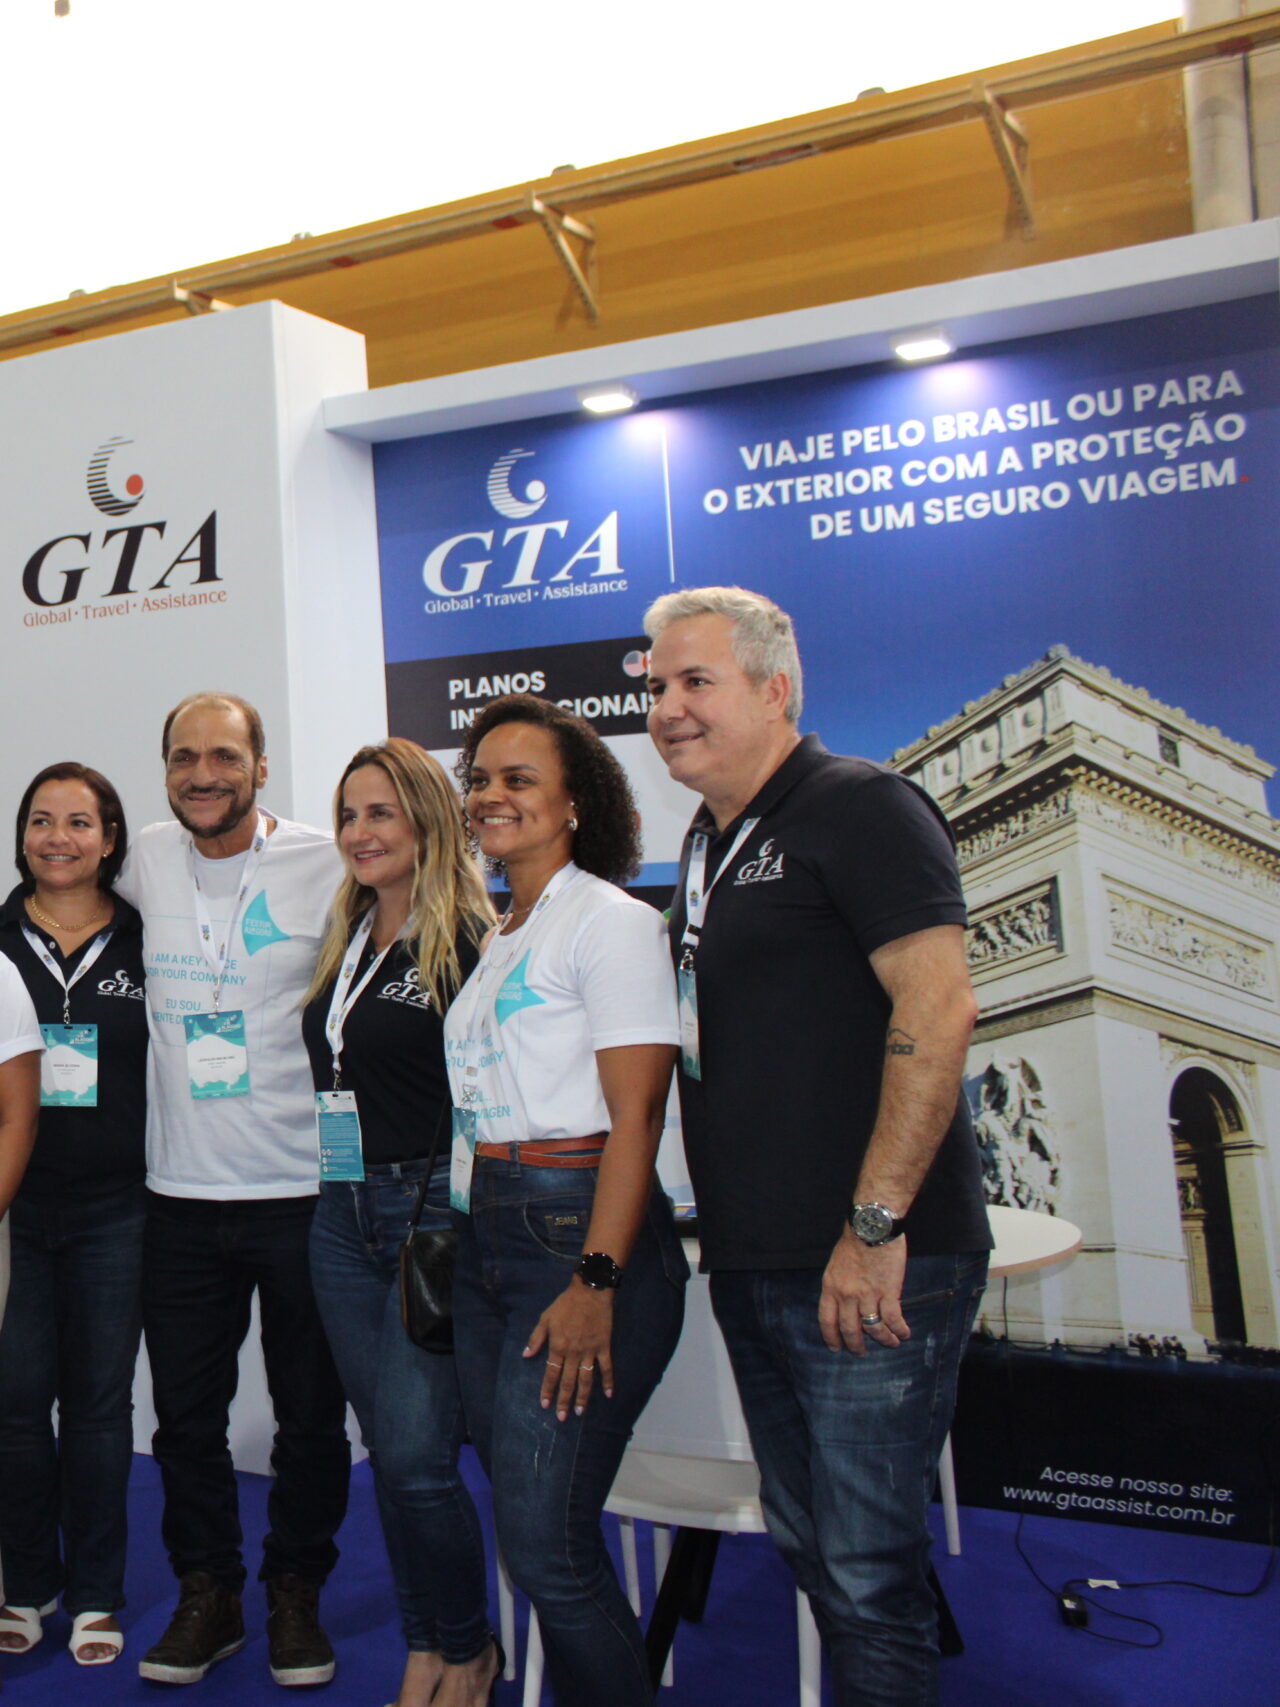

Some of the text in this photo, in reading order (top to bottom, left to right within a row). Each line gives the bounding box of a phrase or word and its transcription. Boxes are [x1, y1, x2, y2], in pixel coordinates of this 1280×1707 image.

[739, 368, 1245, 472] VIAJE PELO BRASIL OU PARA
[702, 411, 1247, 515] O EXTERIOR COM A PROTEÇÃO
[809, 512, 854, 541] DE
[859, 500, 917, 535] UM
[922, 480, 1072, 526] SEGURO
[21, 509, 224, 608] GTA
[421, 510, 625, 598] GTA
[23, 589, 229, 628] Global Travel Assistance
[424, 578, 628, 615] Global Travel Assistance
[448, 670, 546, 700] PLANOS
[737, 852, 785, 880] GTA
[97, 979, 146, 998] GTA
[161, 969, 188, 980] YOUR
[381, 981, 432, 1006] GTA
[1039, 1465, 1234, 1503] Acesse nosso site:
[1002, 1485, 1237, 1526] www.gtaassist.com.br
